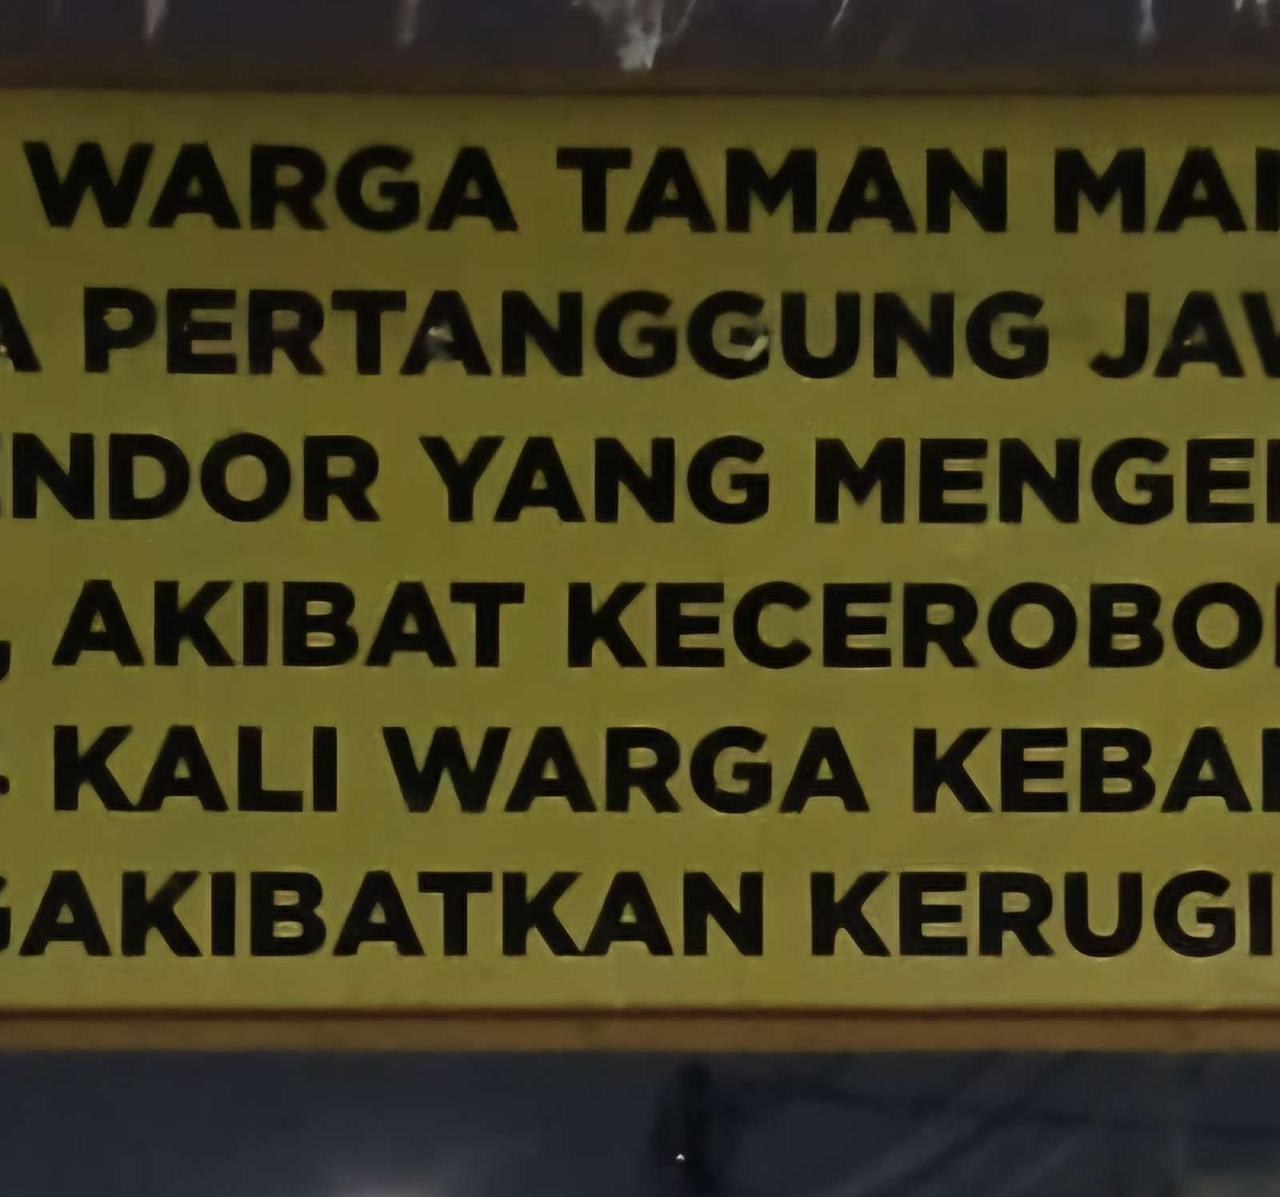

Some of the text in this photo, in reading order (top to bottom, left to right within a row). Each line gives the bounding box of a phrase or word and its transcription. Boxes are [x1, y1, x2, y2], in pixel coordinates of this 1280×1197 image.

[25, 142, 518, 232] WARGA
[556, 148, 1008, 234] TAMAN
[83, 287, 1050, 380] PERTANGGUNG
[419, 435, 770, 525] YANG
[51, 579, 526, 668] AKIBAT
[53, 725, 338, 813] KALI
[382, 725, 870, 814] WARGA
